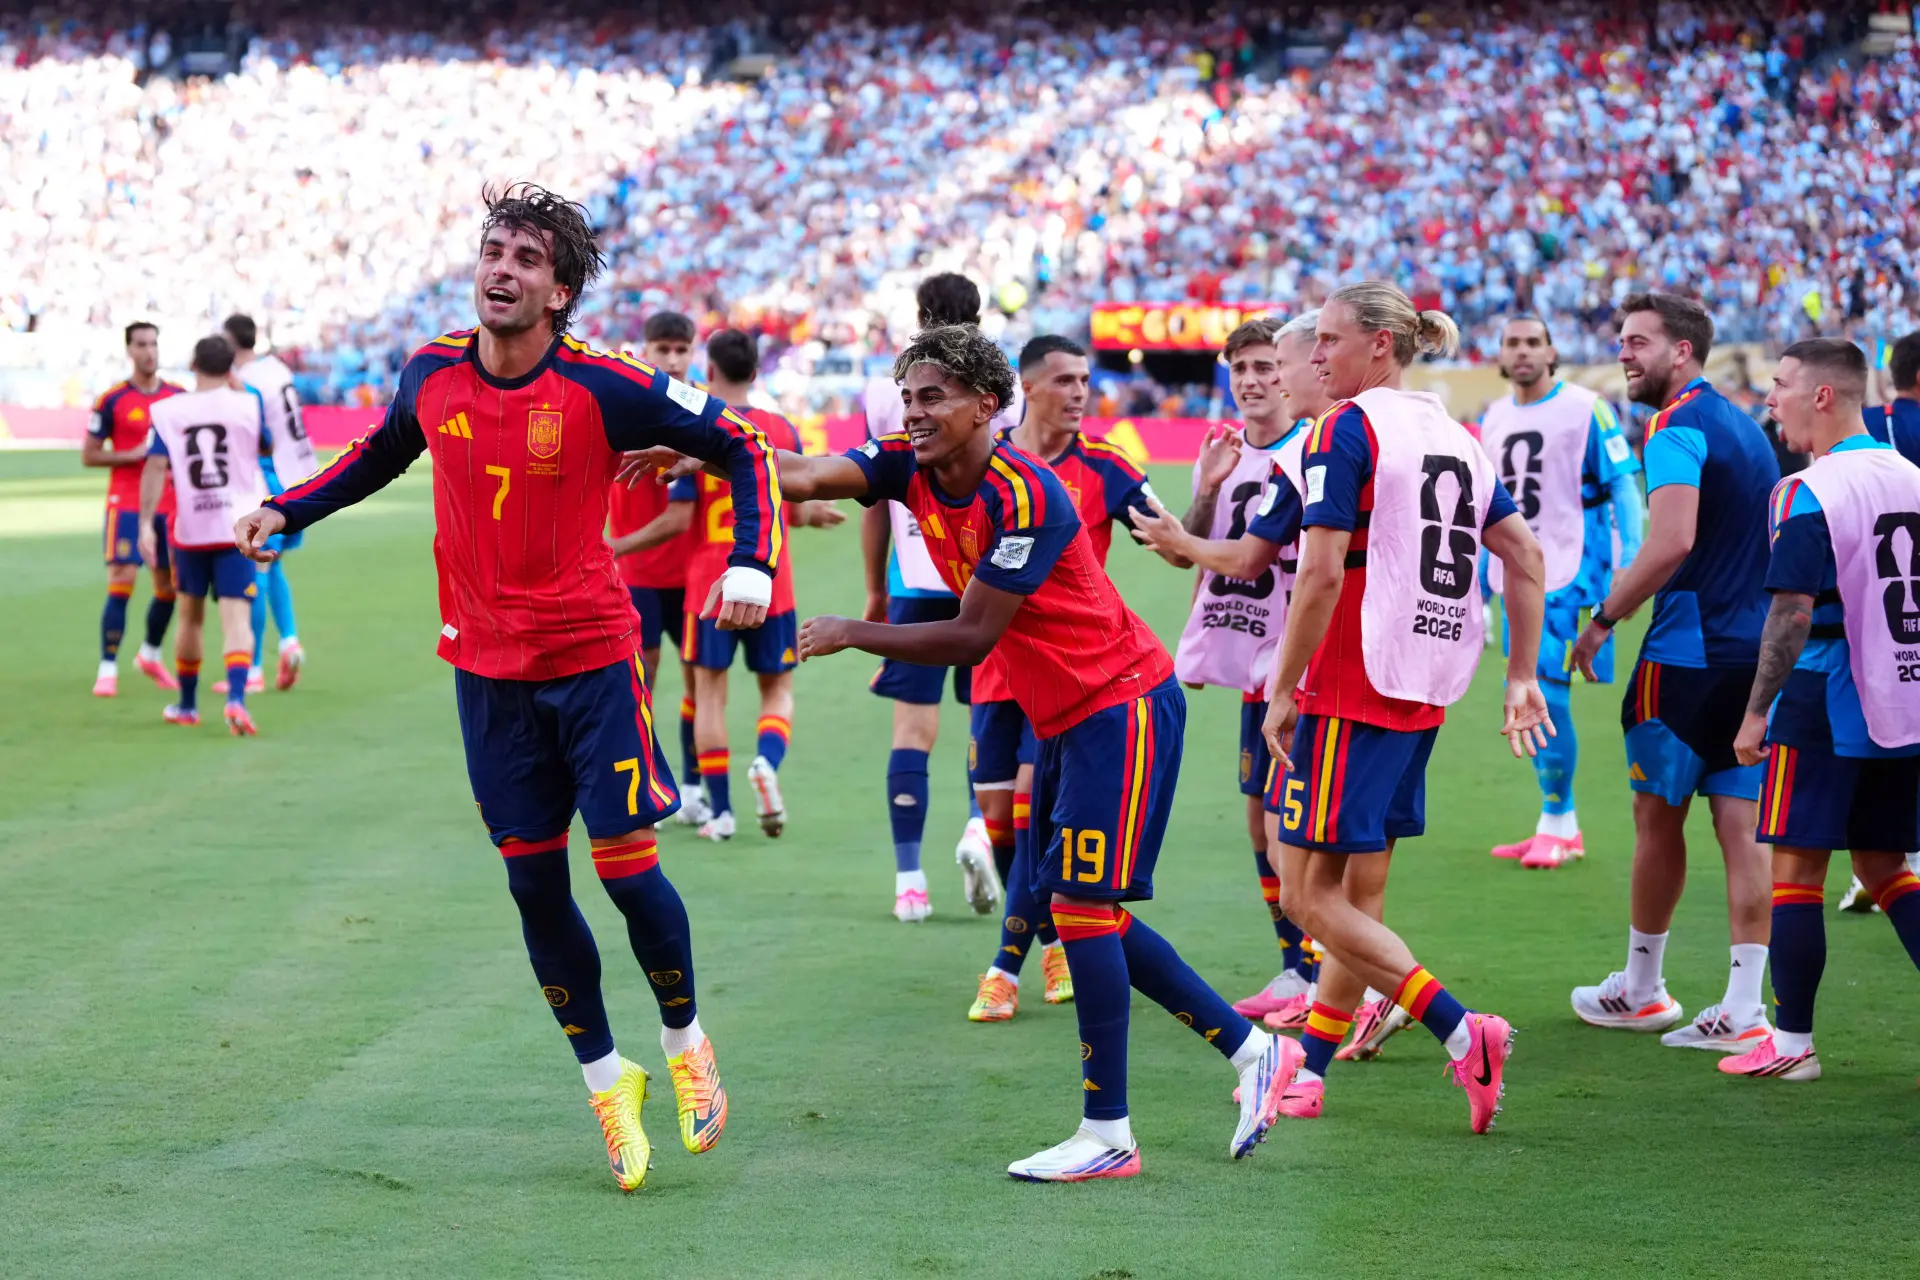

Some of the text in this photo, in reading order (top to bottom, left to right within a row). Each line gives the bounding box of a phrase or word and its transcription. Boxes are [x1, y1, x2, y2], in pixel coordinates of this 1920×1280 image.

[485, 464, 510, 521] 7
[1433, 567, 1456, 586] FIFA
[1203, 600, 1270, 618] WORLD CUP
[1417, 599, 1466, 619] WORLD CUP
[1412, 614, 1463, 641] 2026
[1902, 617, 1920, 632] FIF
[1893, 649, 1920, 661] WORL
[1897, 664, 1920, 682] 20
[613, 757, 641, 816] 7
[1283, 778, 1305, 831] 5
[1062, 828, 1106, 883] 19
